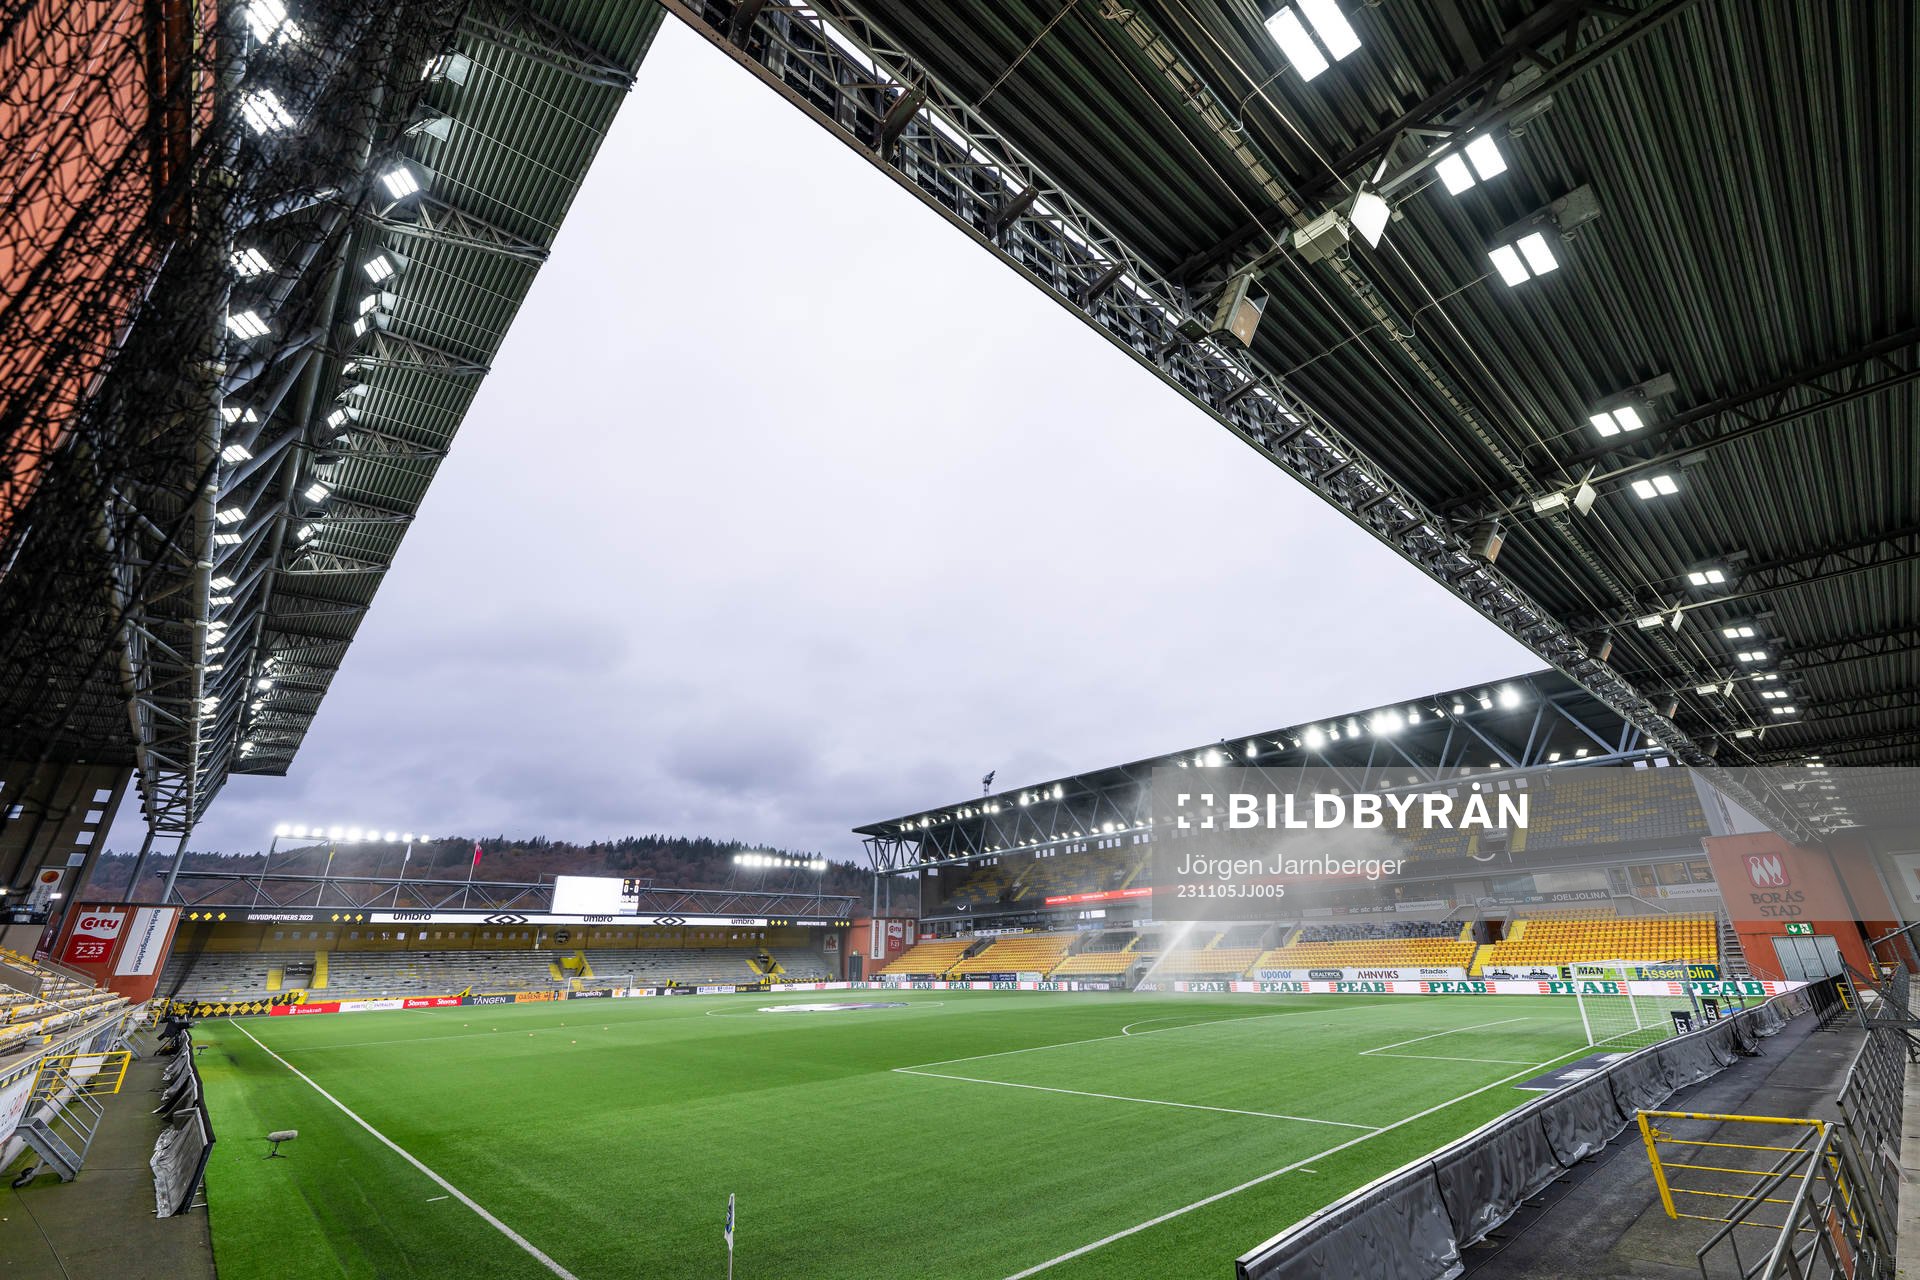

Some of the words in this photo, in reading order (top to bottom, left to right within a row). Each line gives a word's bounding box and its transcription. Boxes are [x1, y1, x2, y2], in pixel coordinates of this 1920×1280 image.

[1750, 889, 1805, 904] BORÅS
[1759, 905, 1801, 917] STAD
[80, 917, 119, 931] City
[583, 915, 613, 923] umbro
[731, 917, 755, 925] umbro
[1261, 970, 1292, 980] uponor
[1358, 970, 1399, 979] AHNVIKS
[1642, 966, 1715, 979] Assemblin
[1188, 982, 1225, 992] PEAB
[1260, 982, 1303, 992] PEAB
[1336, 982, 1386, 993] PEAB
[1428, 981, 1487, 993] PEAB
[1549, 981, 1620, 994] PEAB
[1682, 981, 1766, 996] PEAB
[473, 995, 506, 1005] TÅNGEN
